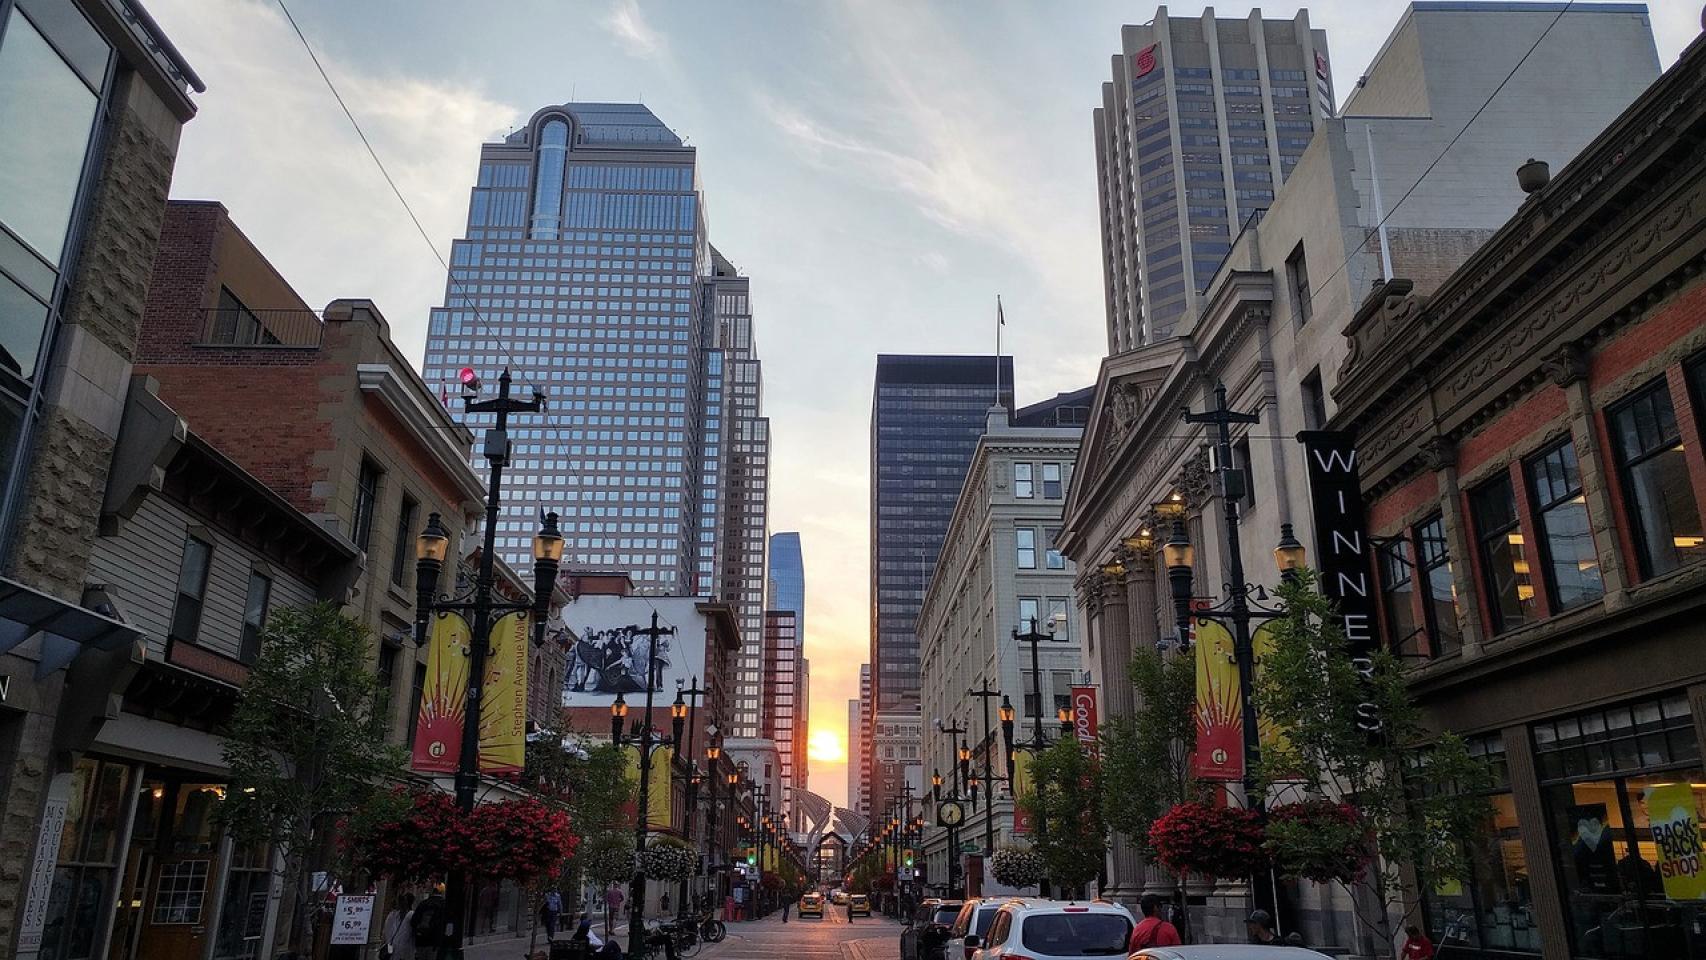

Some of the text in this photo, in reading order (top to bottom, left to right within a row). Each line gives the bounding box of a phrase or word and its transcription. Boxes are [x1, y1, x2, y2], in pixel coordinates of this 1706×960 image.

[1314, 449, 1382, 730] WINNERS
[514, 644, 524, 686] Avenue
[512, 690, 524, 736] Stephen
[25, 806, 55, 927] MAGAZINES
